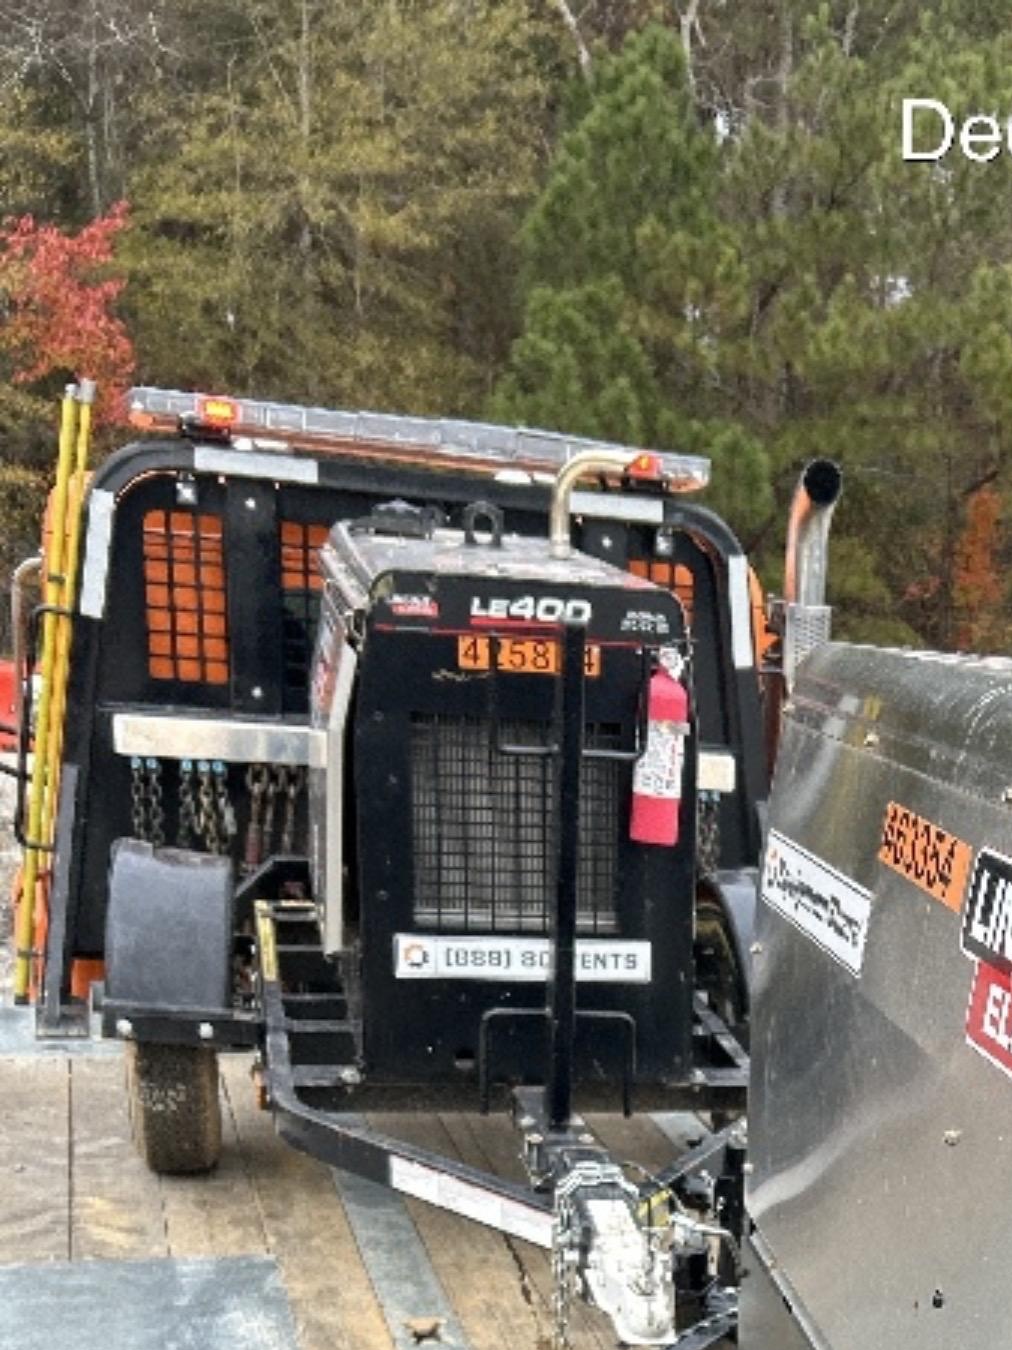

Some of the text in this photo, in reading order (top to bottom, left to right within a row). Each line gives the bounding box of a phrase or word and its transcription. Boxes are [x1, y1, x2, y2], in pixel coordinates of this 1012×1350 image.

[470, 596, 592, 623] LE400
[462, 638, 595, 674] 4584
[520, 950, 638, 970] 80ENTS
